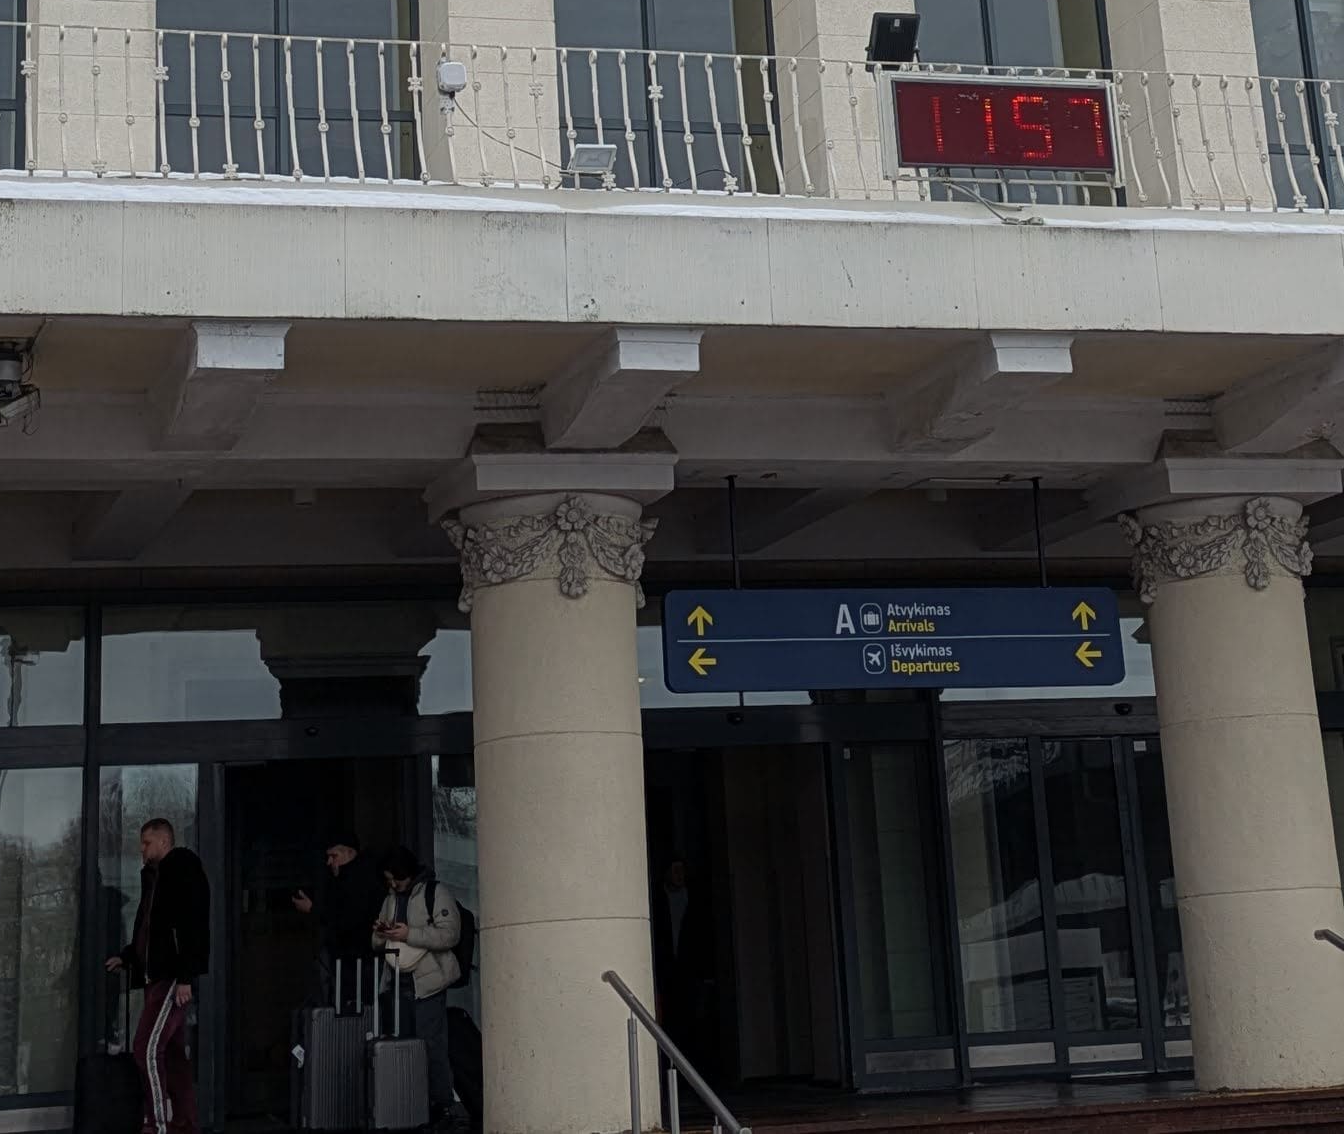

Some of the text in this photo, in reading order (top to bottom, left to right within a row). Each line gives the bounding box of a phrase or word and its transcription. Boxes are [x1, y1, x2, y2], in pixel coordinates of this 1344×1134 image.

[835, 603, 856, 635] A
[887, 602, 951, 619] Atvykimas
[888, 619, 936, 633] Arrivals
[890, 643, 953, 660] Išvykimas
[891, 659, 961, 676] Departures
